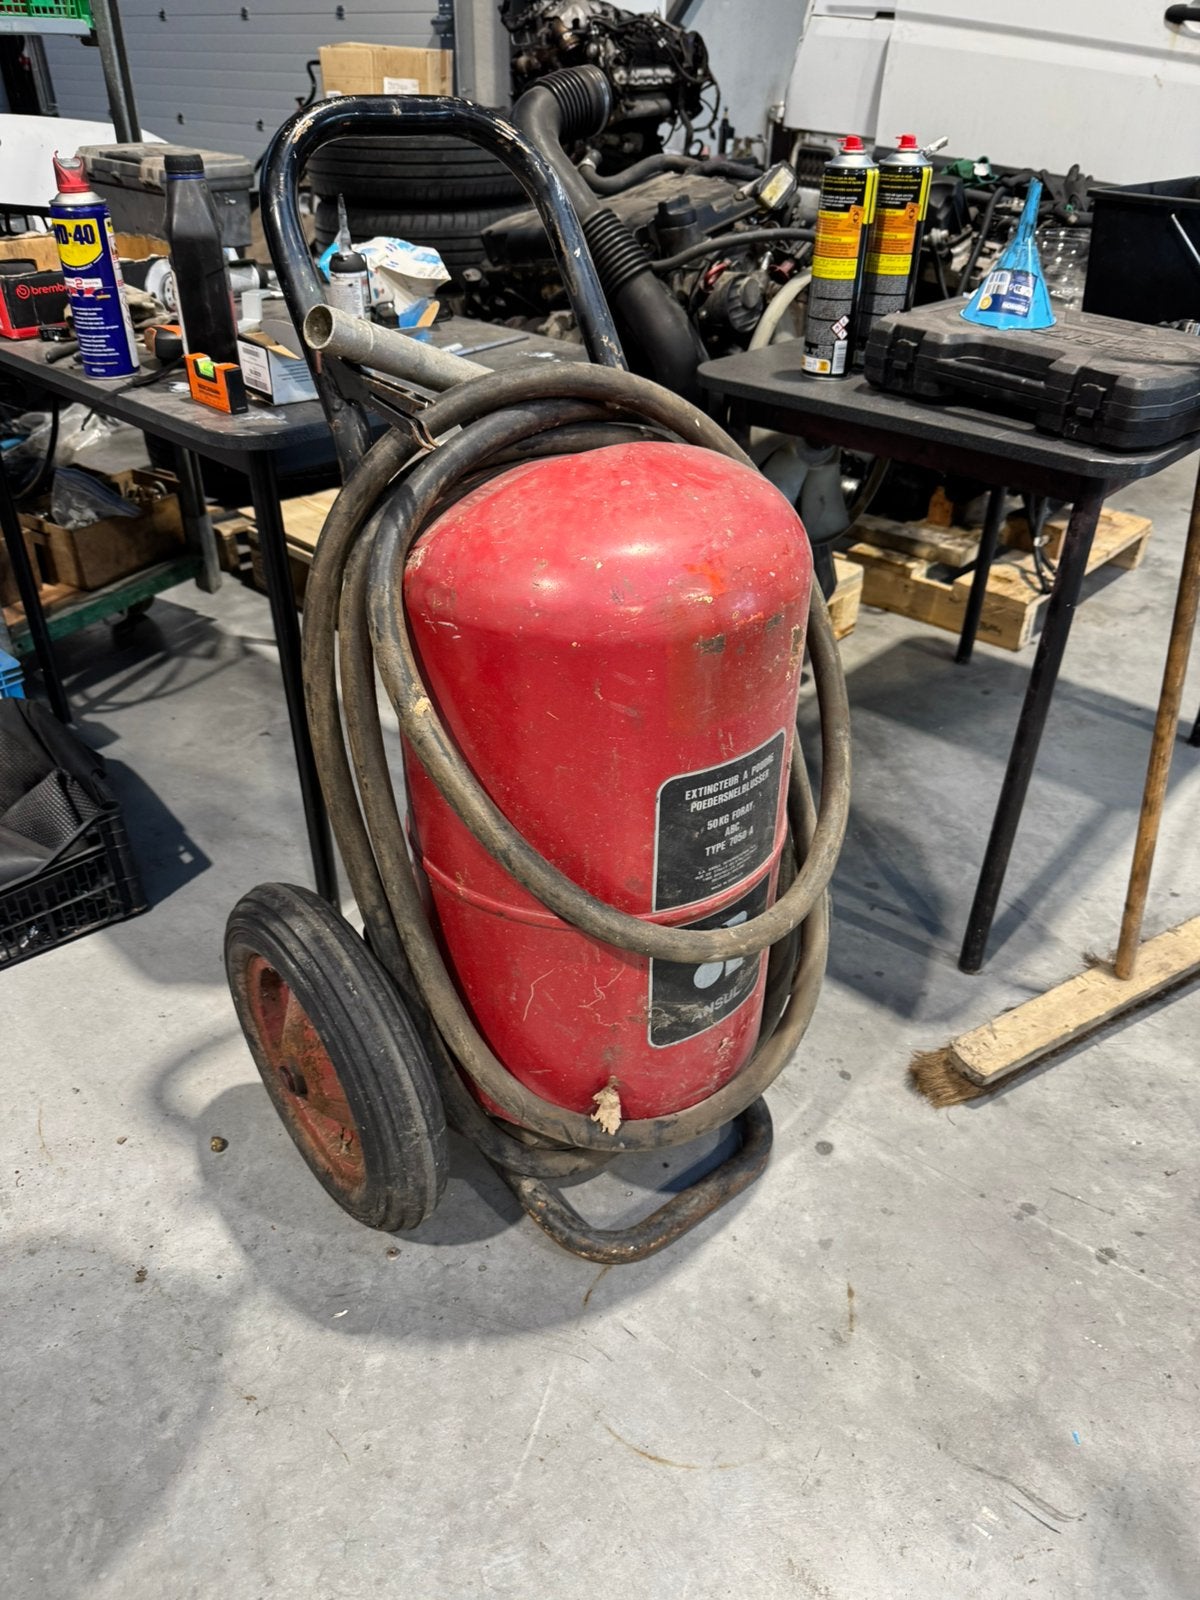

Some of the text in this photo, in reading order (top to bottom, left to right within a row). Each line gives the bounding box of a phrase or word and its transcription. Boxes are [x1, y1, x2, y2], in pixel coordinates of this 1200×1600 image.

[685, 774, 739, 800] EXTINCTEUR
[743, 770, 748, 780] A
[732, 801, 753, 820] FORAY
[725, 822, 740, 837] ABC
[705, 841, 726, 856] TYPE
